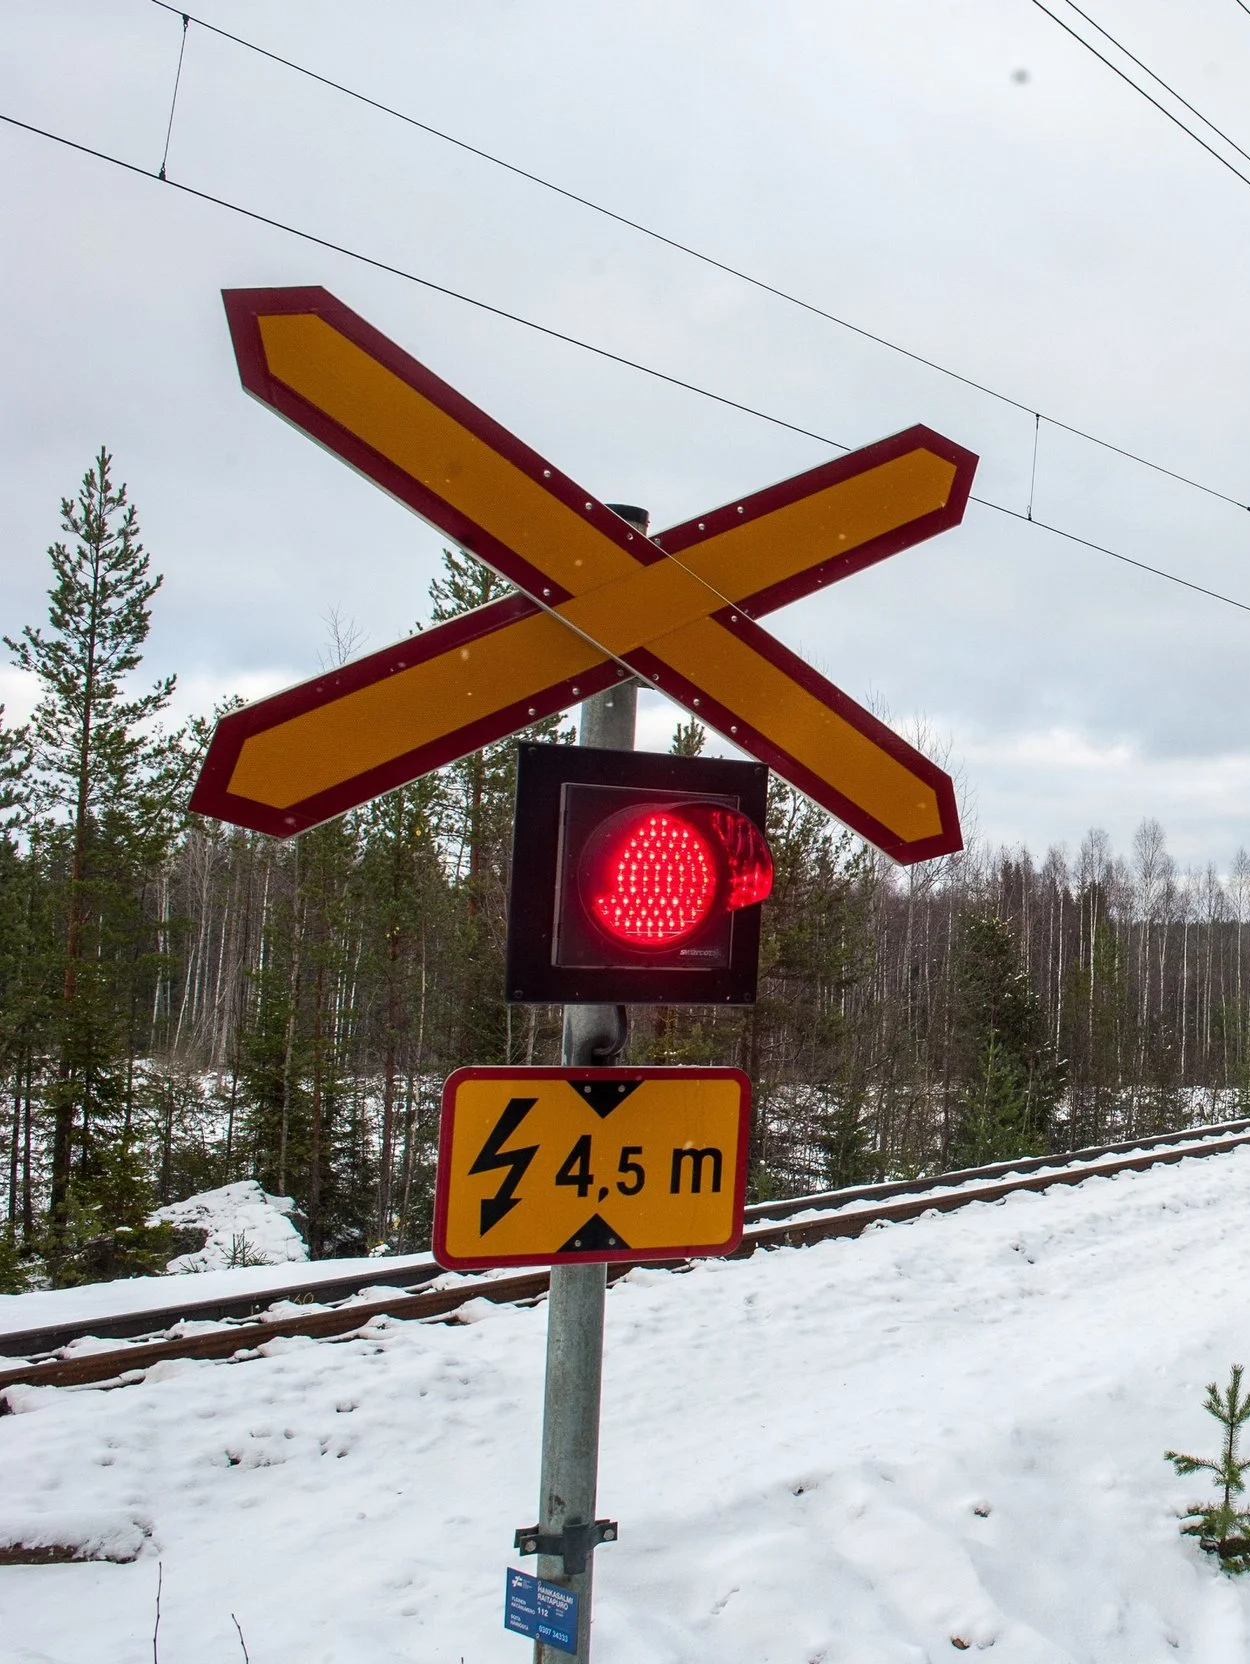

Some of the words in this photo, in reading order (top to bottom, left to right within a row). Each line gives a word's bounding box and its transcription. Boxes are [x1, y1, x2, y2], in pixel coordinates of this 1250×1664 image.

[554, 1134, 646, 1204] 4,5
[669, 1146, 723, 1194] m
[537, 1593, 568, 1610] RAITAPURO
[538, 1586, 573, 1604] HANKASALMI
[538, 1607, 548, 1616] 112
